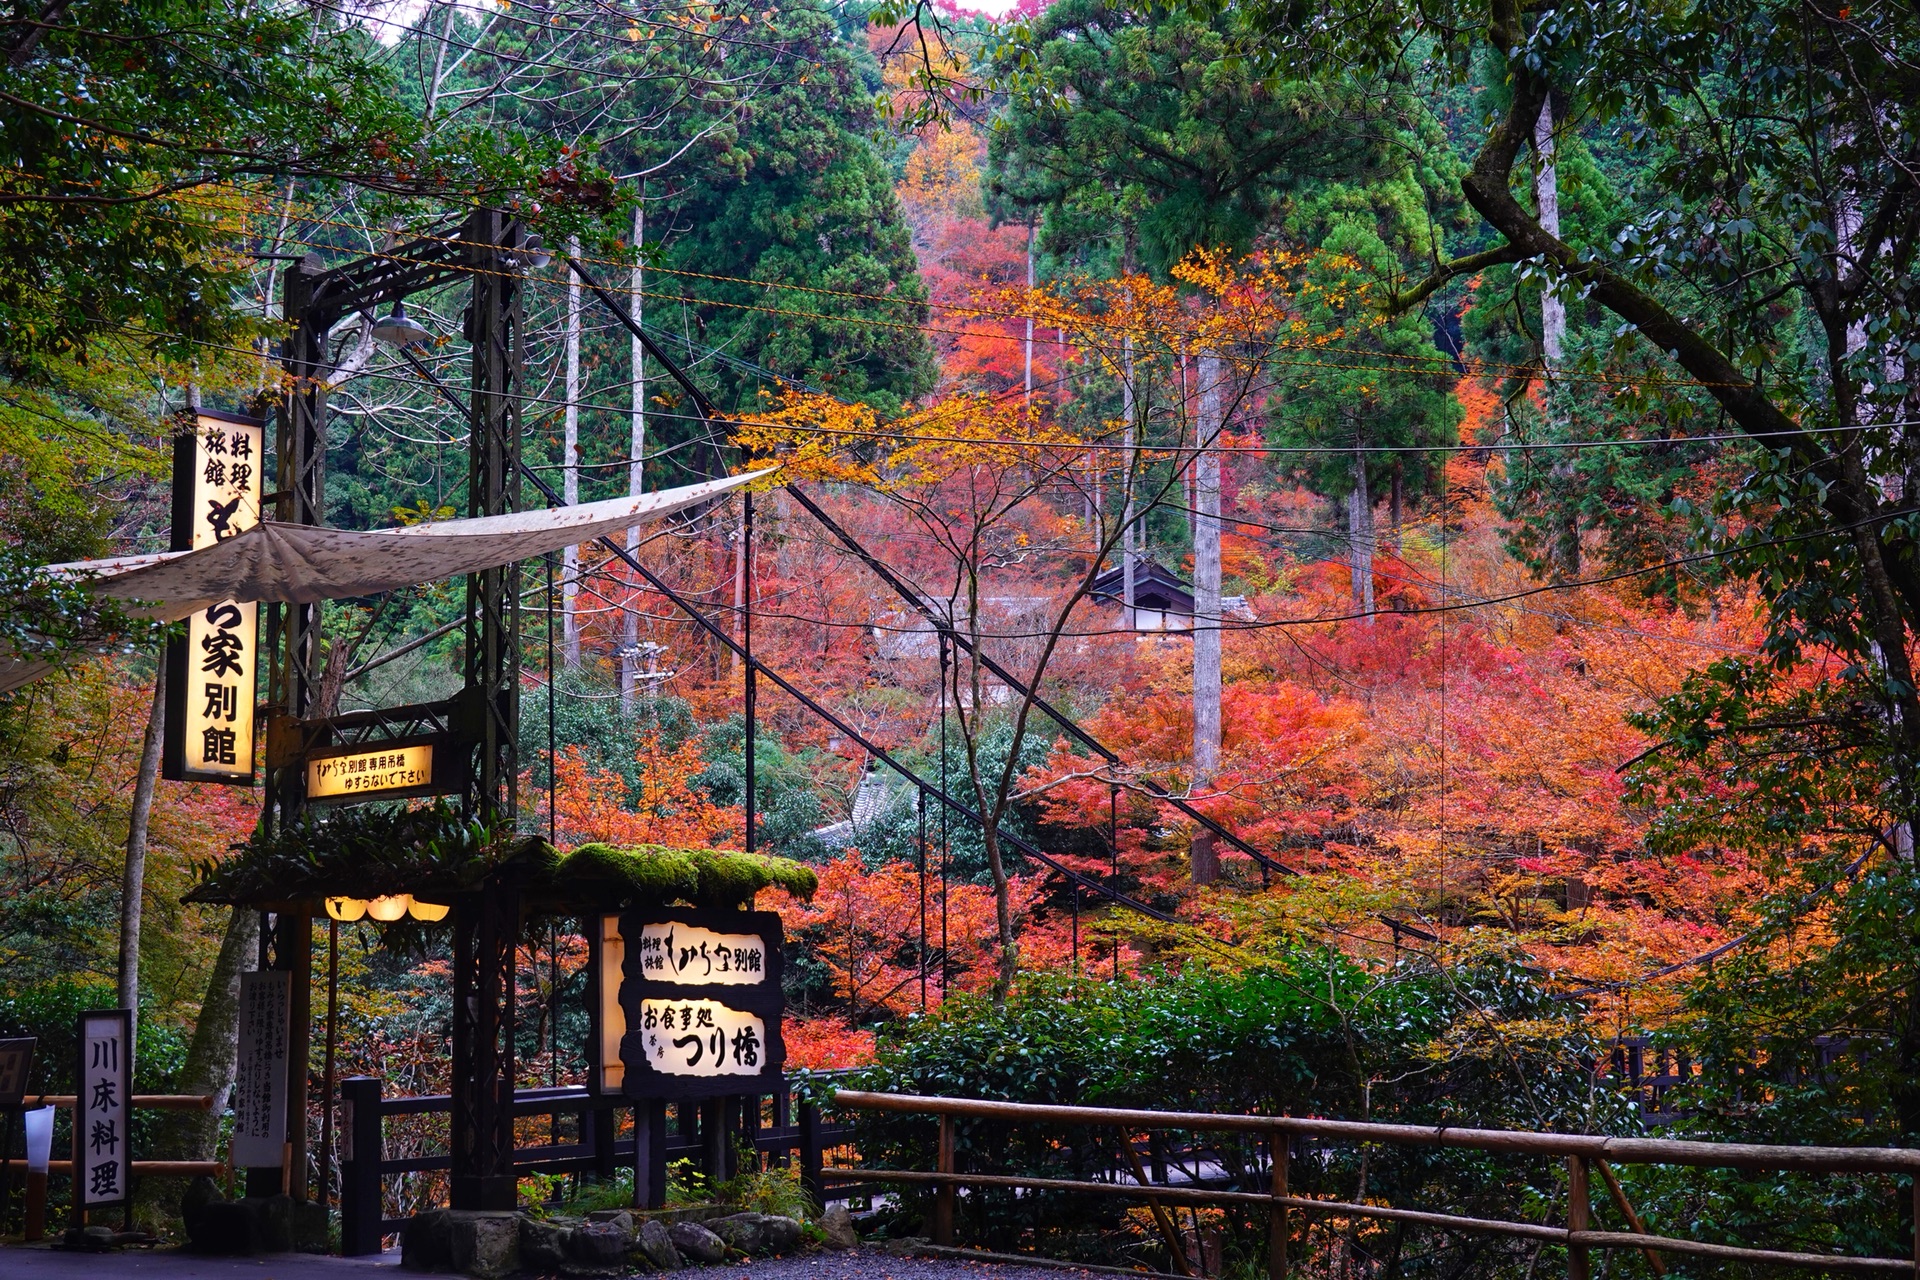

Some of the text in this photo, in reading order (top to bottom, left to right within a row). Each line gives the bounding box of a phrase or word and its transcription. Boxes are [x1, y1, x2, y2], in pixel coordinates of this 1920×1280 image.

[203, 426, 228, 487] 旅館
[231, 431, 253, 491] 料理
[344, 769, 425, 790] ゆすらないで下さい
[642, 936, 661, 952] 料理
[644, 955, 664, 970] 旅館
[275, 980, 286, 1059] いらっしゃいませ
[644, 1004, 715, 1031] お食事処
[673, 1026, 760, 1068] つり橋
[90, 1038, 119, 1196] 川床料理
